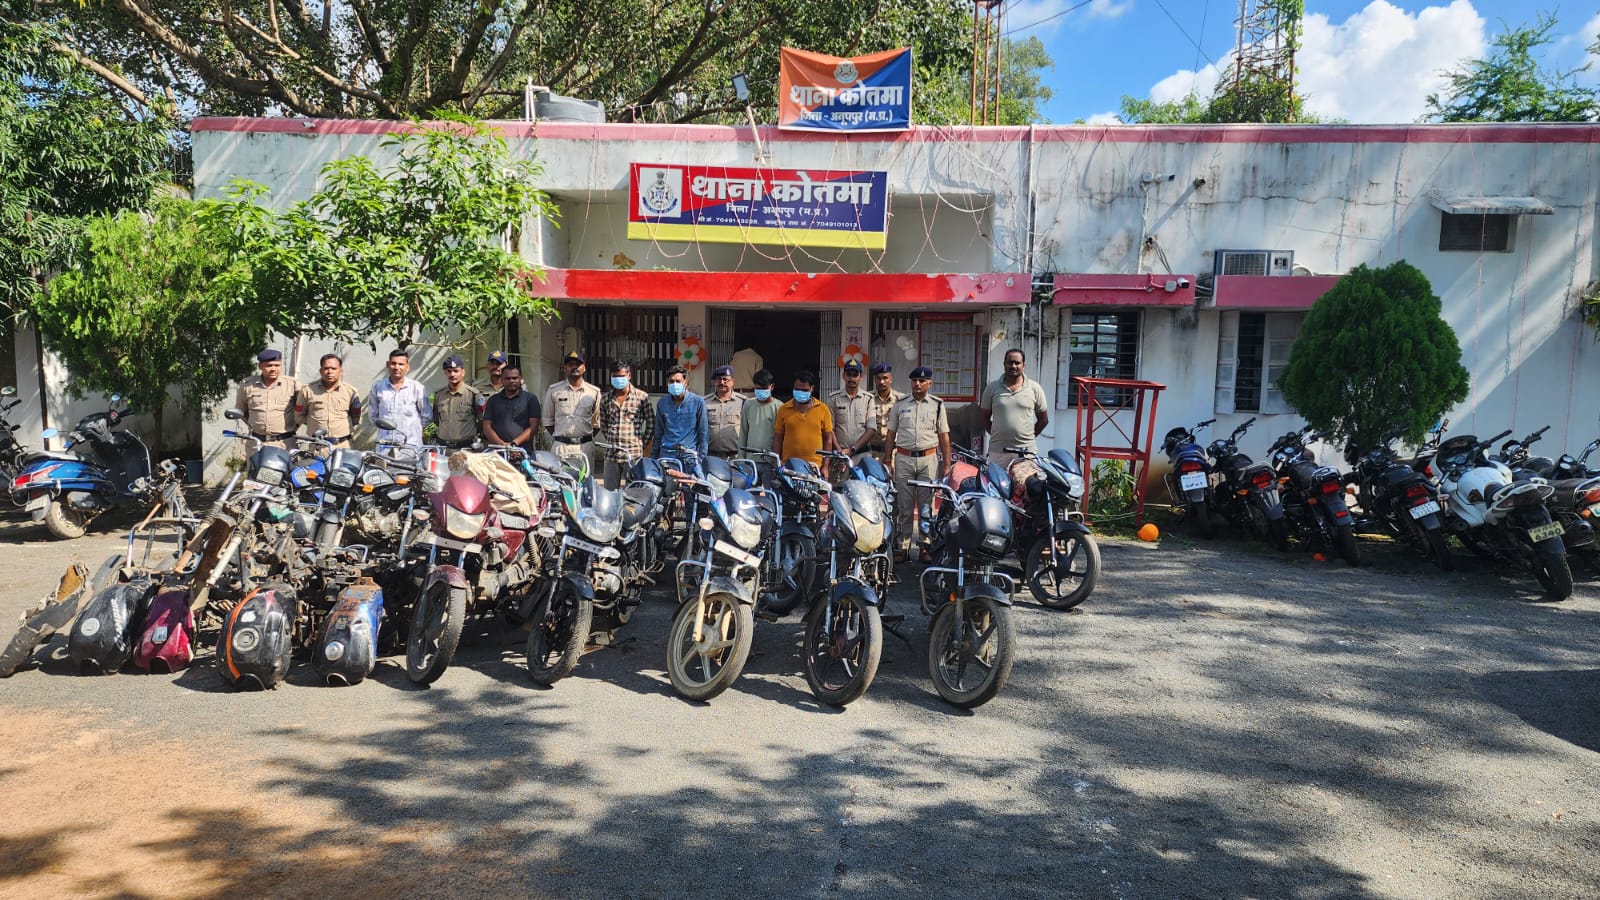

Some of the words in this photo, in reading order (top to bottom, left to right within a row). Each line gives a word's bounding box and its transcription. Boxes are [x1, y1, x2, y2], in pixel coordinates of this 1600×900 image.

[790, 85, 835, 106] थाना
[839, 80, 904, 106] कोतमा
[691, 175, 765, 201] थाना
[769, 171, 873, 205] कोतमा
